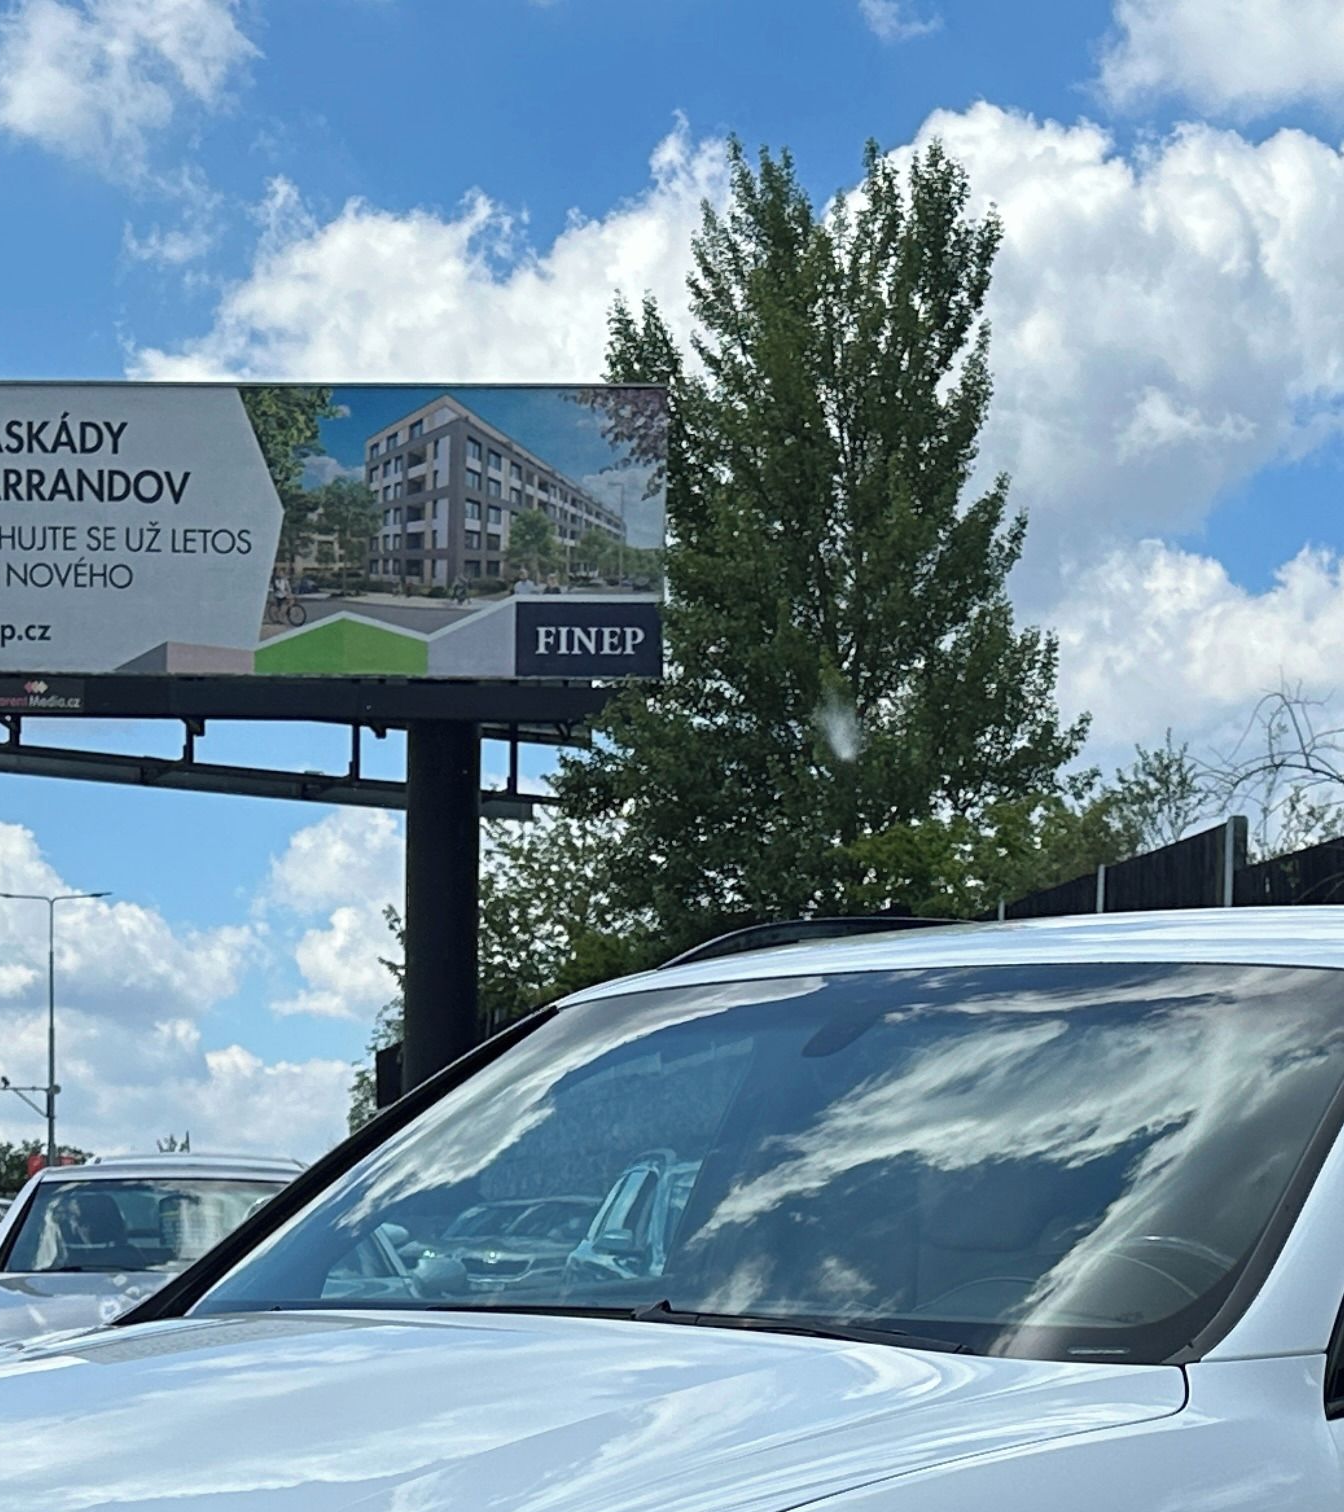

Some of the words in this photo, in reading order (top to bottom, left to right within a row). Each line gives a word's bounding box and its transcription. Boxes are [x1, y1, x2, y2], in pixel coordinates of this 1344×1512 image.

[86, 526, 117, 551] SE
[125, 521, 163, 553] UŽ
[171, 528, 253, 555] LETOS
[6, 557, 134, 589] NOVÉHO
[535, 626, 646, 655] FINEP
